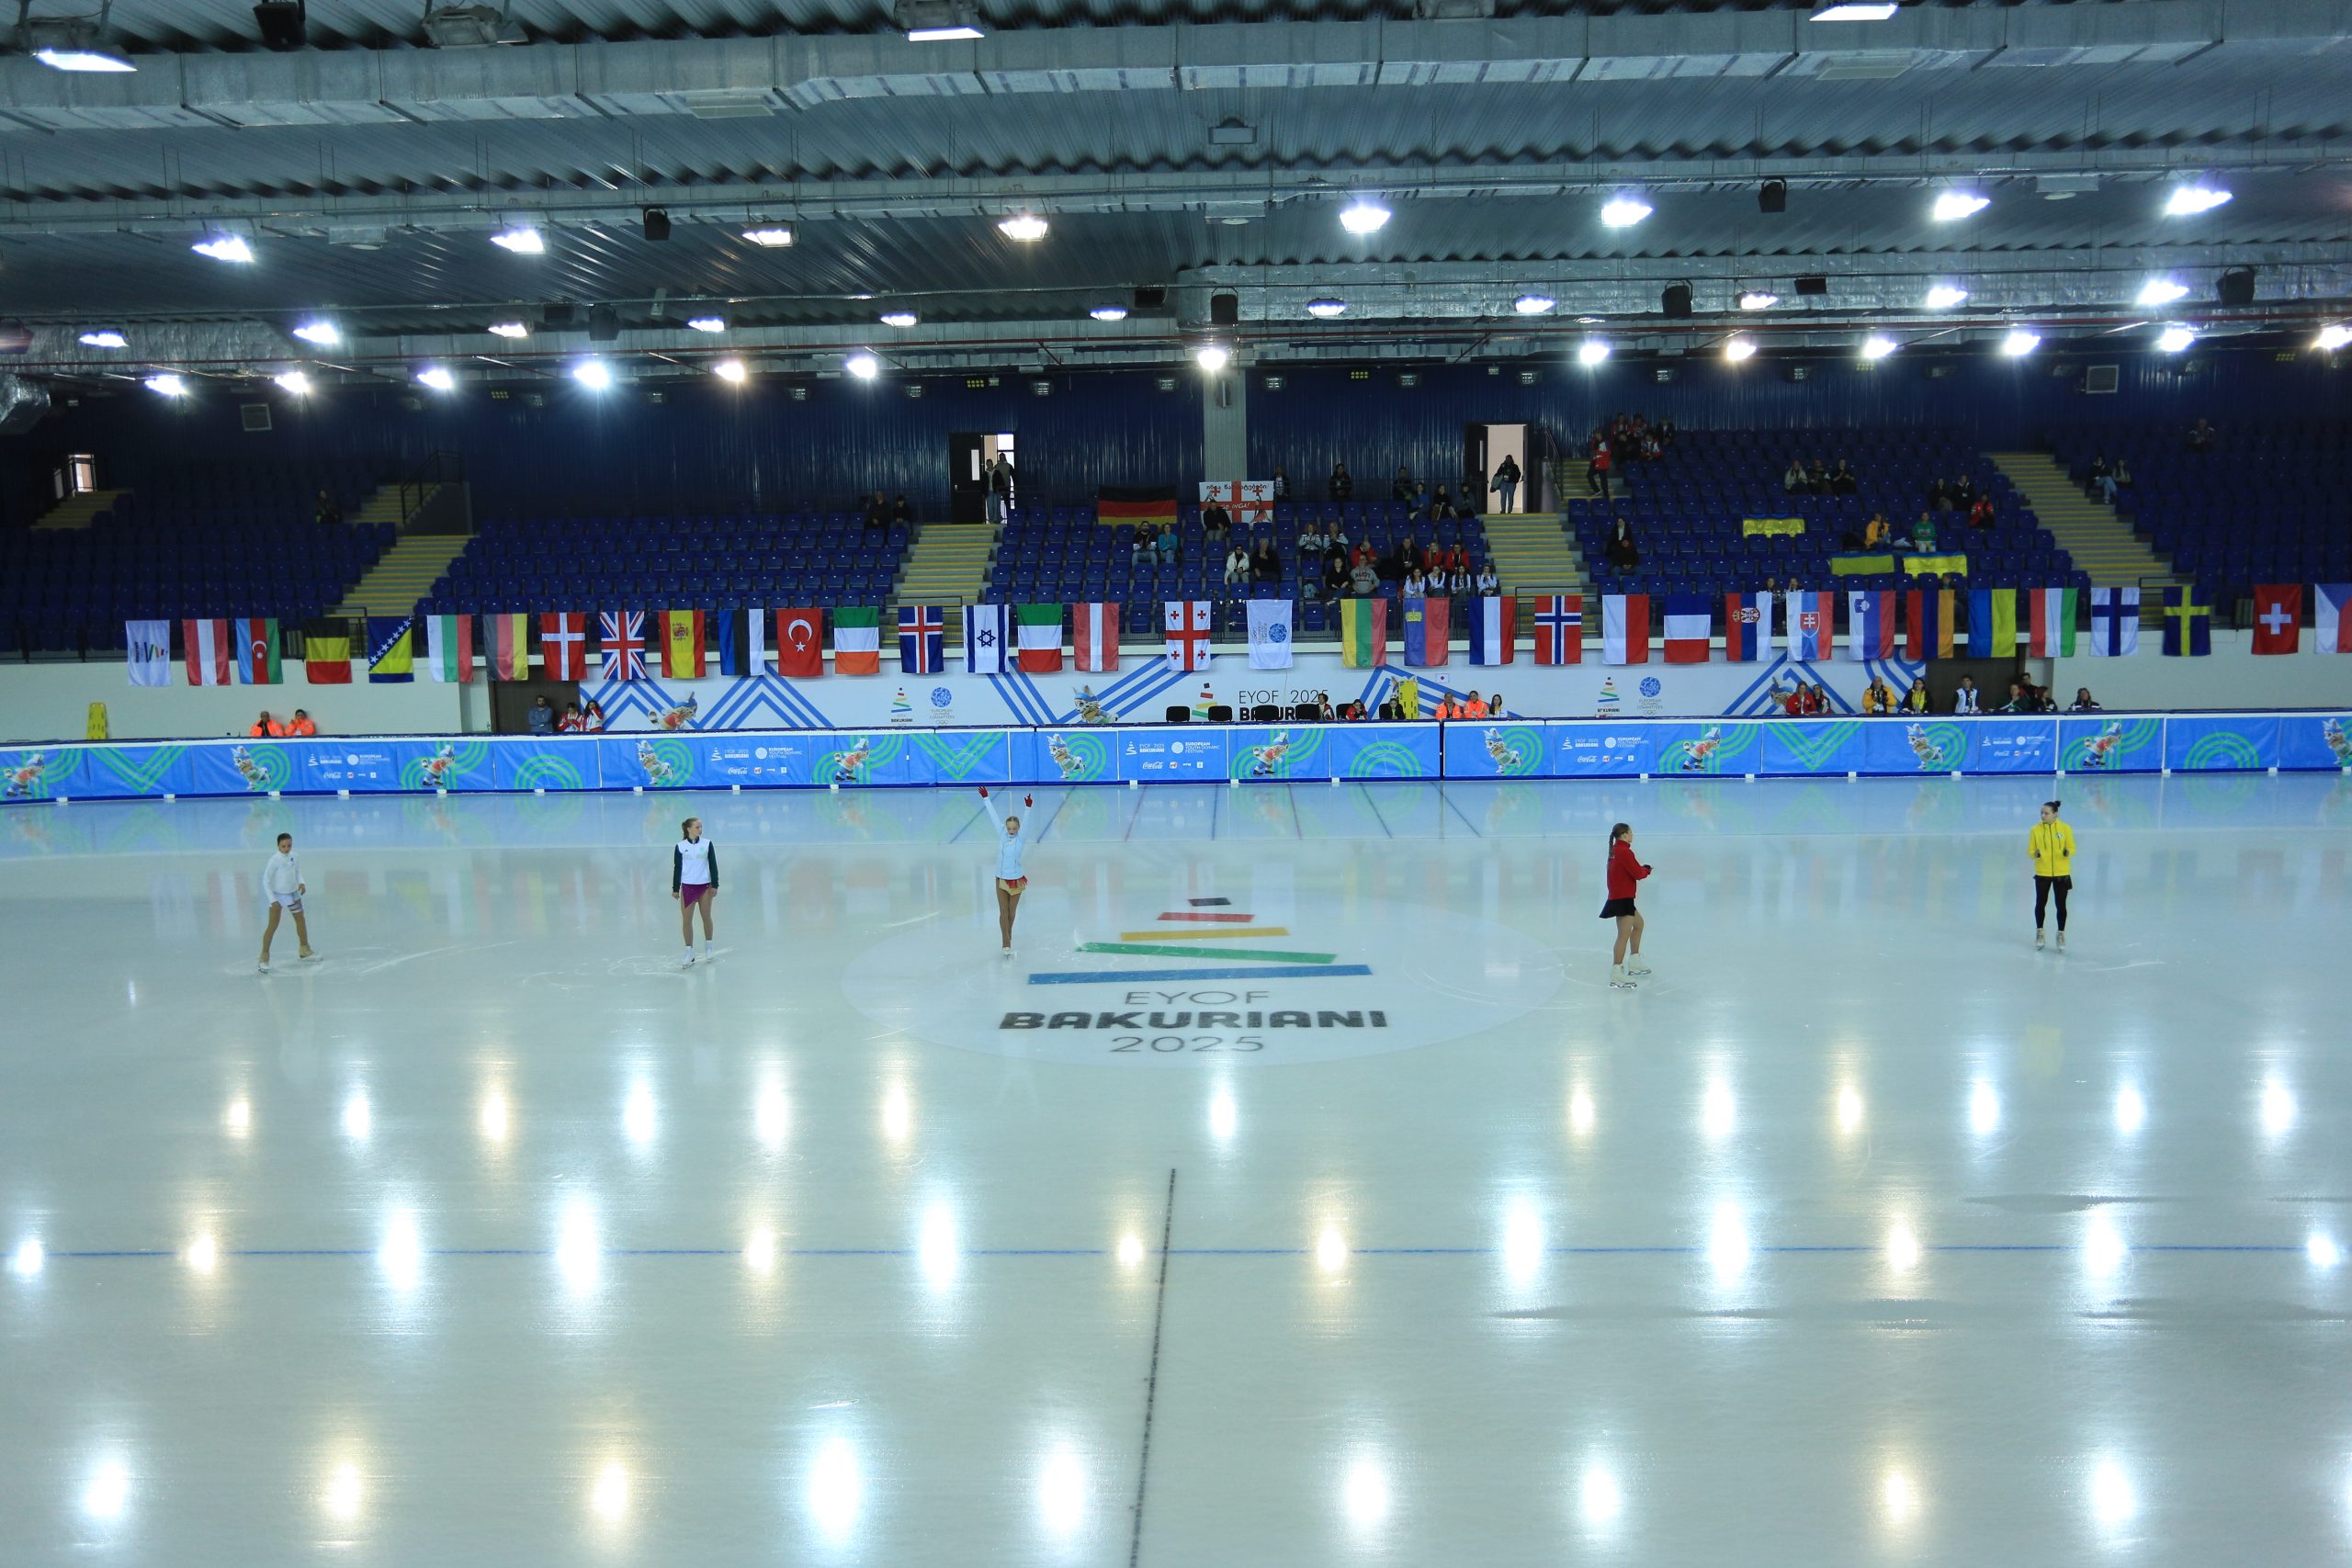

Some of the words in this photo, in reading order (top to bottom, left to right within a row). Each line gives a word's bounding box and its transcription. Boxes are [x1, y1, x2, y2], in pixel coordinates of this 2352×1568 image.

[1232, 502, 1250, 510] INGA!
[1238, 690, 1279, 704] EYOF
[1124, 990, 1271, 1005] EYOF
[998, 1010, 1389, 1030] BAKURIANI
[1108, 1035, 1265, 1053] 2025
